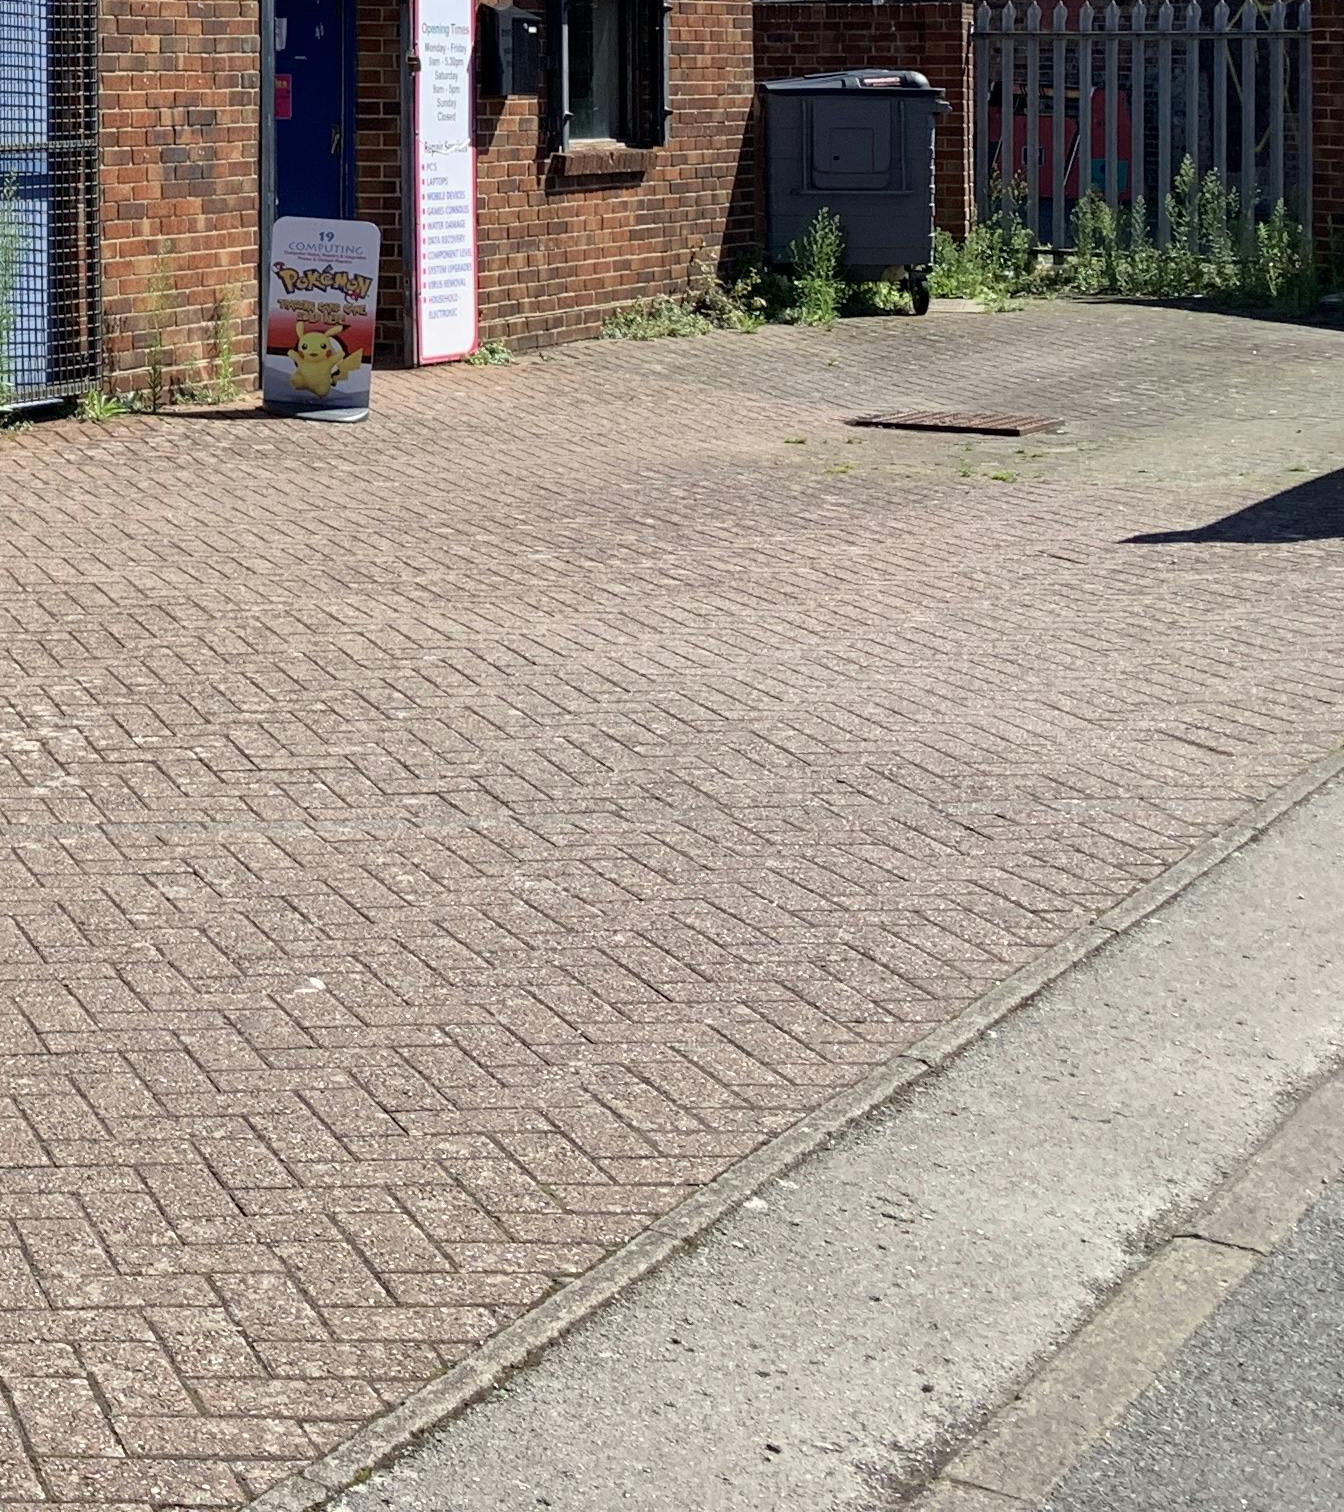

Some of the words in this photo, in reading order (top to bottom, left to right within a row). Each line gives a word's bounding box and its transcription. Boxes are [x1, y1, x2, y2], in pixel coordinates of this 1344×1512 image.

[422, 22, 450, 37] Opening
[450, 22, 469, 35] Times
[424, 42, 446, 55] Monday
[450, 42, 467, 55] Friday
[434, 71, 458, 82] Saturday
[436, 98, 457, 109] Sunday
[437, 112, 456, 121] Closed
[427, 177, 448, 186] LAPTOPS
[319, 231, 335, 242] 19
[288, 242, 364, 255] COMPUTING
